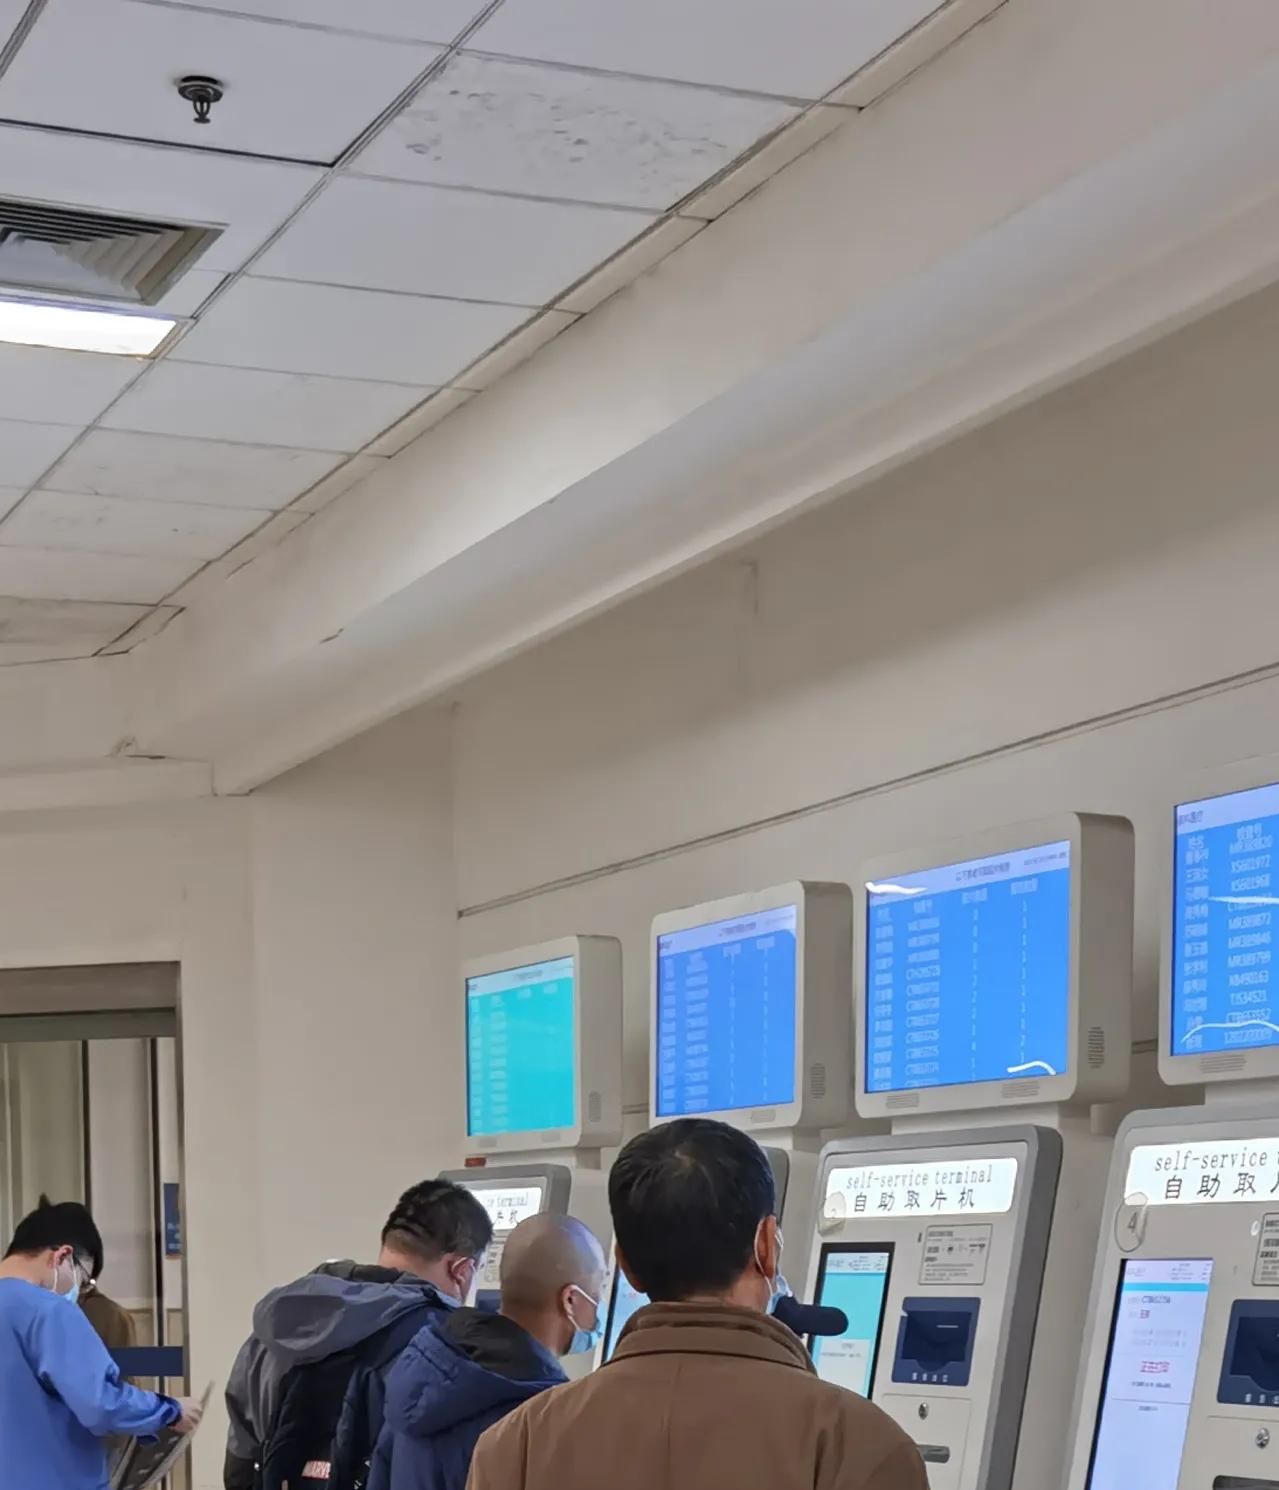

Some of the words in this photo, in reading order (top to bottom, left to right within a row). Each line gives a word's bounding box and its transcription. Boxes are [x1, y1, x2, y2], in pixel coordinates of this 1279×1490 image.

[1155, 1147, 1268, 1172] self-service
[846, 1168, 929, 1190] self-service
[935, 1164, 993, 1185] terminal
[854, 1187, 975, 1213] 自助取片机
